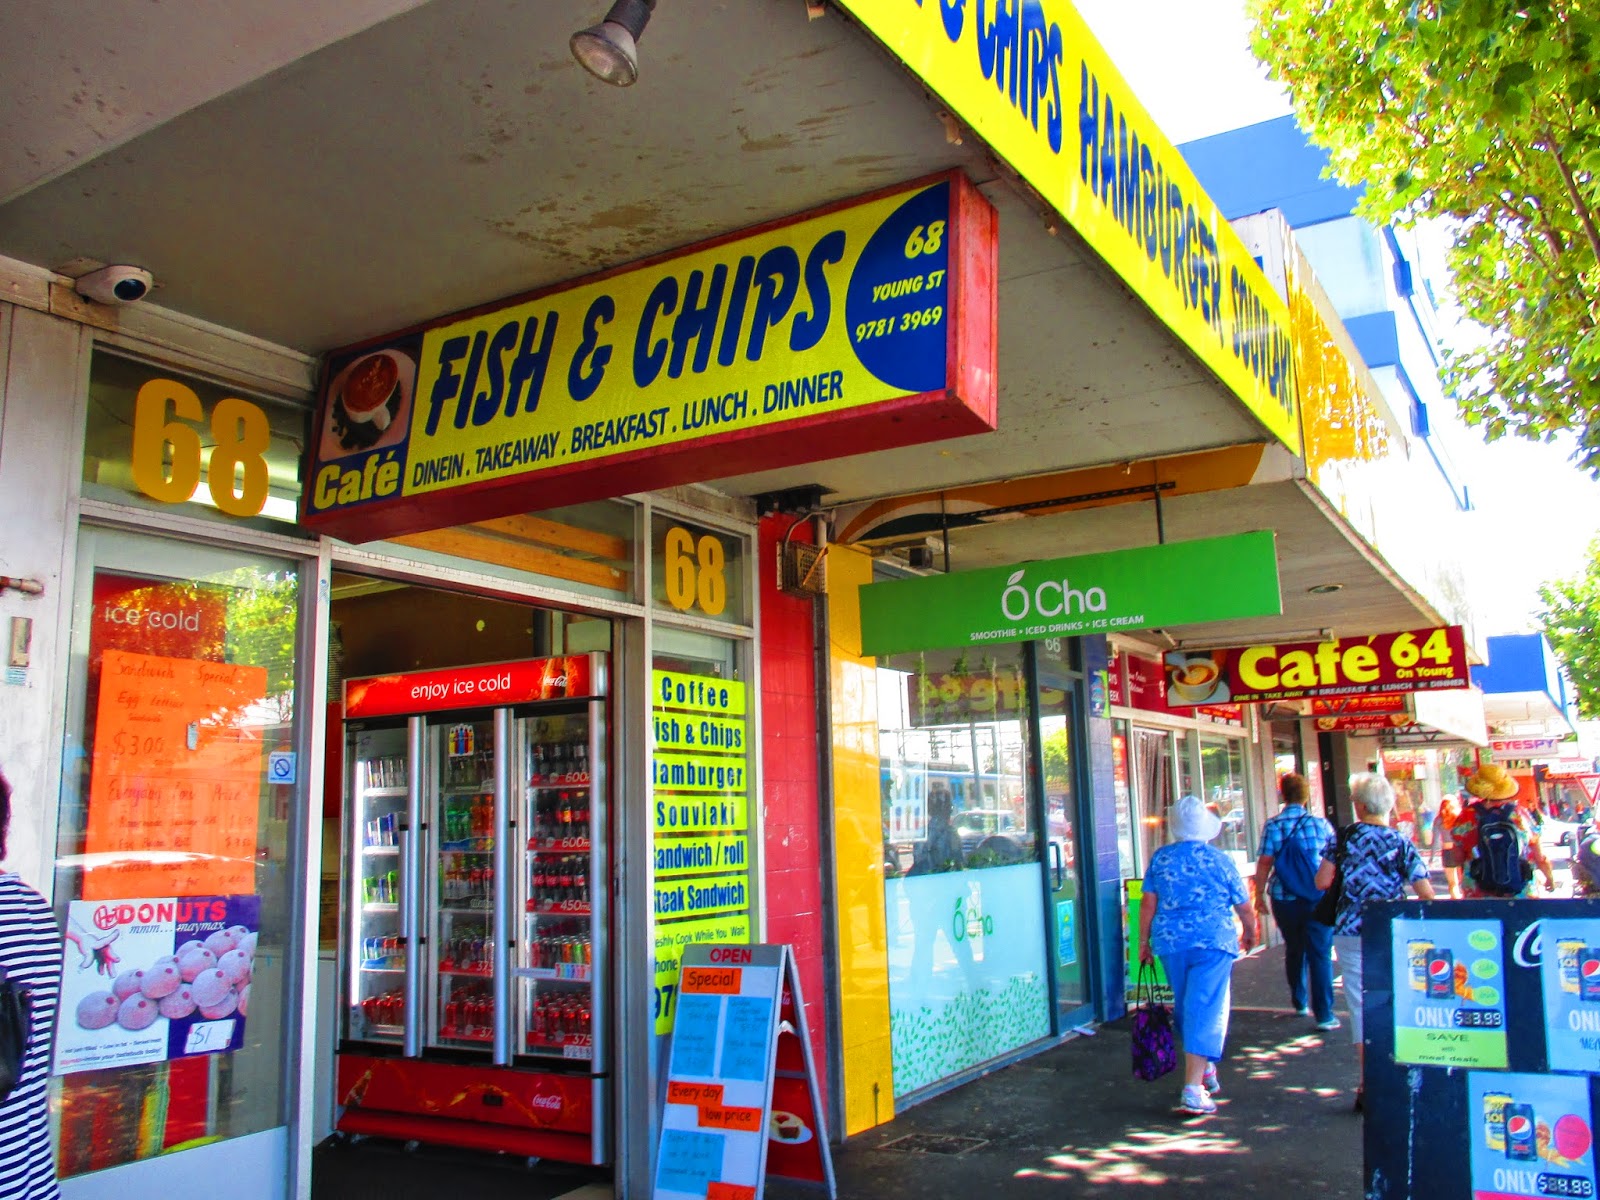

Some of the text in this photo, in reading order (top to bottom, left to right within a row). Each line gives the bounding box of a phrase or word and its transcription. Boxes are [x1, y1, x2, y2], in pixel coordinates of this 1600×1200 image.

[976, 0, 1063, 154] CHIPS
[1079, 58, 1225, 349] HAMBURGER
[904, 220, 945, 260] 68
[872, 269, 946, 303] YOUNG ST
[425, 229, 846, 437] FISH & CHIPS
[855, 305, 943, 343] 9781 3969
[412, 369, 844, 488] DINEIN TAKEAWAY BREAKFAST LUNCH DINNER
[131, 377, 271, 518] 68
[313, 450, 400, 511] Café
[665, 526, 726, 616] 68
[1035, 578, 1107, 618] Cha
[104, 601, 199, 631] ice cold
[969, 614, 1145, 641] SMOOTHIE ICED DRINKS ICE CREAM
[1044, 637, 1062, 652] 66
[1238, 629, 1453, 690] Café 64
[1396, 666, 1454, 680] On Young
[196, 664, 237, 687] Special
[411, 672, 511, 700] enjoy ice cold
[662, 676, 729, 708] Coffee
[1264, 691, 1282, 699] TAKE
[1319, 685, 1367, 696] BREAKFAST
[1382, 681, 1413, 690] LUNCH
[653, 716, 741, 749] ish & Chips
[1492, 739, 1554, 751] EYESPY
[657, 800, 735, 827] Souvlaki
[724, 840, 744, 865] roll
[687, 881, 745, 911] Sandwich
[117, 900, 227, 925] DONUTS
[675, 932, 693, 945] Cook
[695, 929, 714, 942] While
[715, 927, 728, 939] You
[731, 926, 746, 936] Wait
[709, 947, 753, 963] OPEN
[687, 969, 735, 989] Special
[1414, 1006, 1456, 1028] ONLY
[190, 1024, 211, 1047] $1
[1426, 1032, 1470, 1042] SAVE
[671, 1084, 722, 1101] Every day
[704, 1107, 752, 1125] low price
[1493, 1168, 1538, 1194] ONLY
